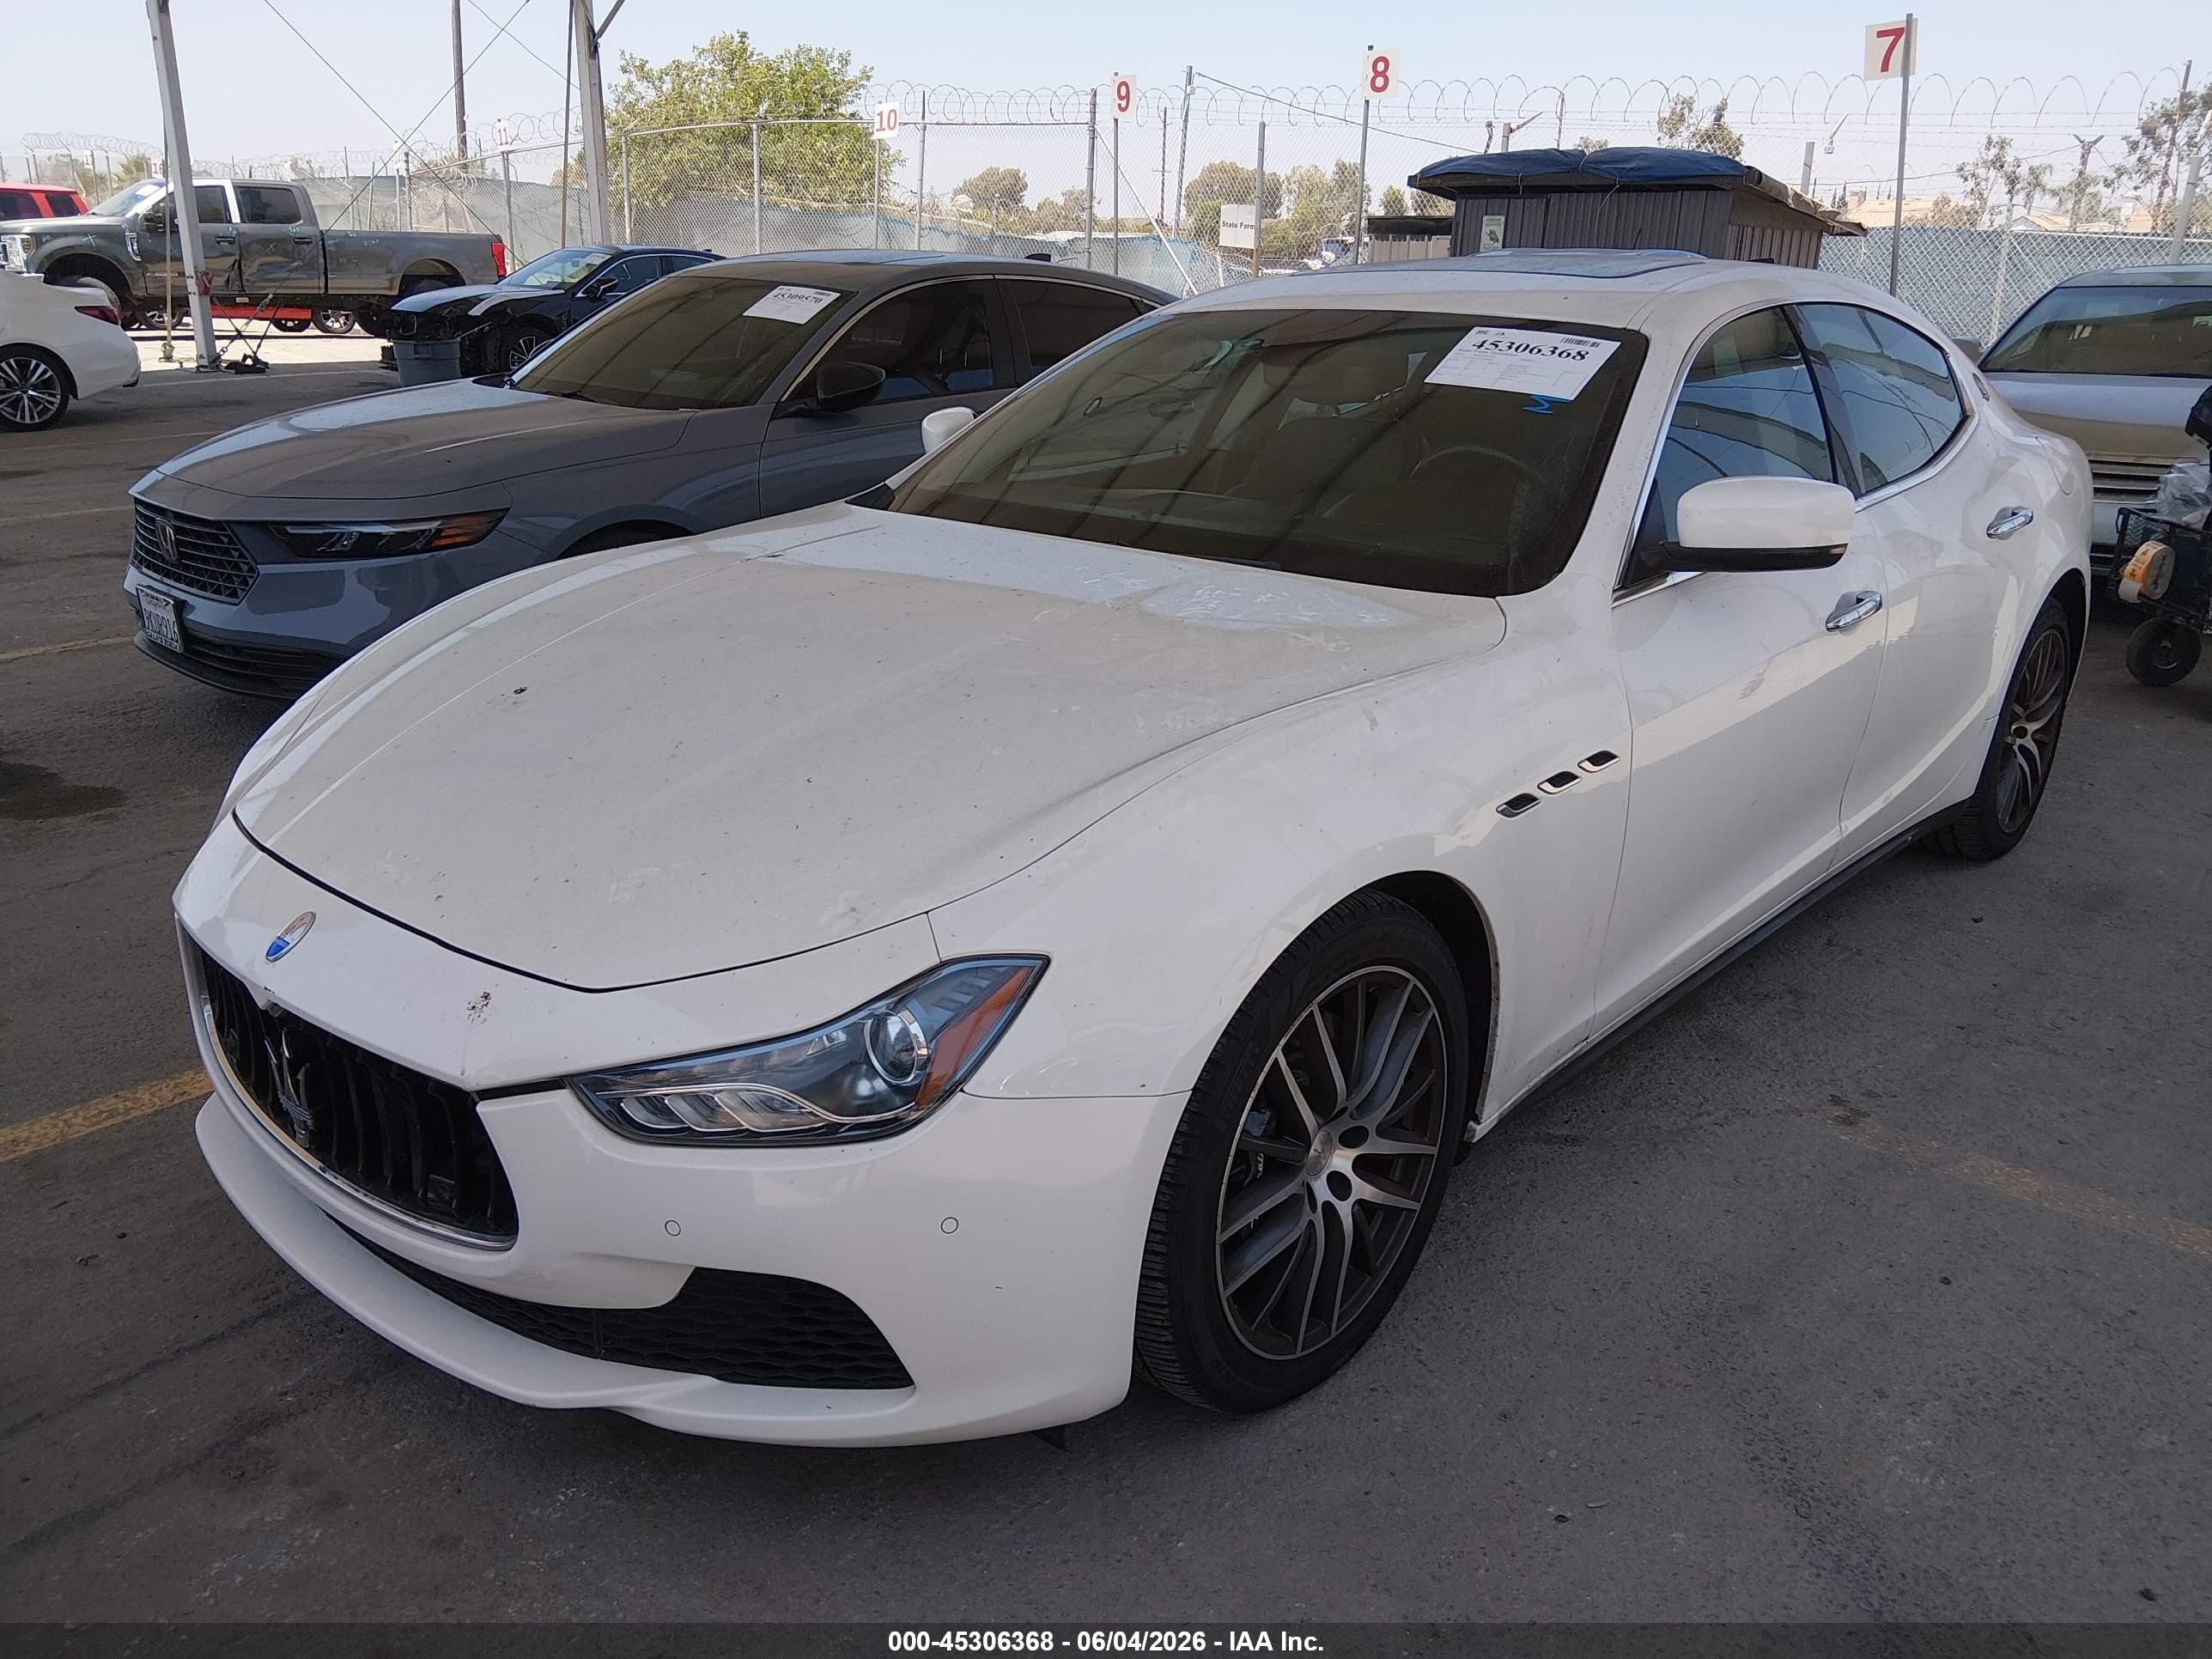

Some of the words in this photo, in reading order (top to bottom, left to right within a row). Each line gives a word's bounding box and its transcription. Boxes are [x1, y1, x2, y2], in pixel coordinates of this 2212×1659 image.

[1876, 27, 1905, 72] 7
[1370, 56, 1389, 93] 8
[1117, 81, 1130, 112] 9
[876, 109, 897, 131] 10
[498, 127, 509, 145] 11
[1222, 220, 1237, 228] State
[1240, 222, 1255, 230] Farm
[1472, 339, 1589, 362] 45306368
